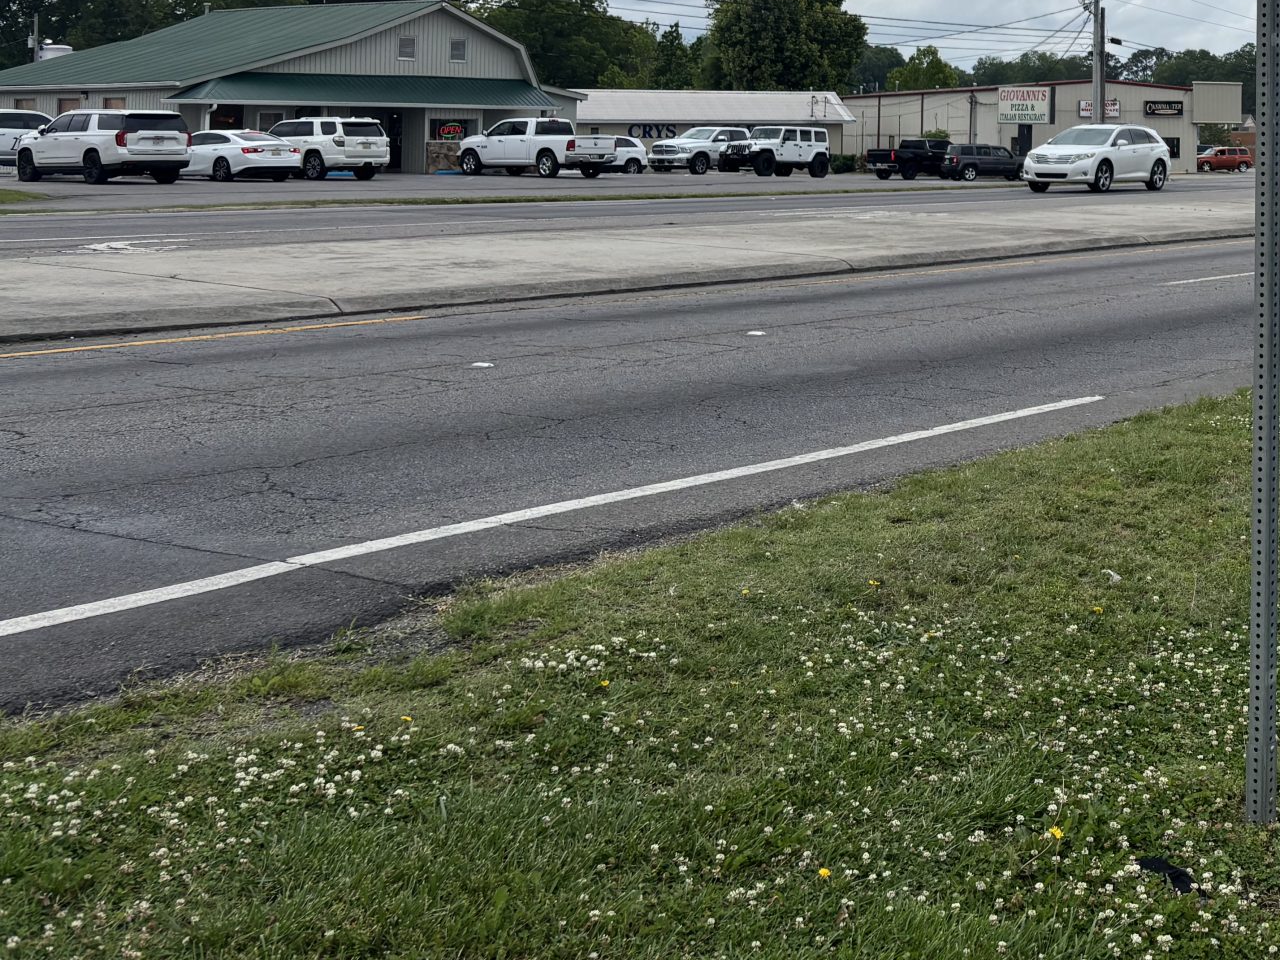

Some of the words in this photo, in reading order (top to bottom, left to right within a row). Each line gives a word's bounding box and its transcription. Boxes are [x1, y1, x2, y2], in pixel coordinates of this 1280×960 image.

[1000, 89, 1047, 101] GIOVANNI'S
[1010, 103, 1029, 111] PIZZA
[1031, 103, 1035, 111] &
[1000, 113, 1017, 121] ITALIAN
[1018, 113, 1046, 121] RESTAURANT
[441, 126, 461, 134] OPEN
[628, 124, 676, 139] CRYS
